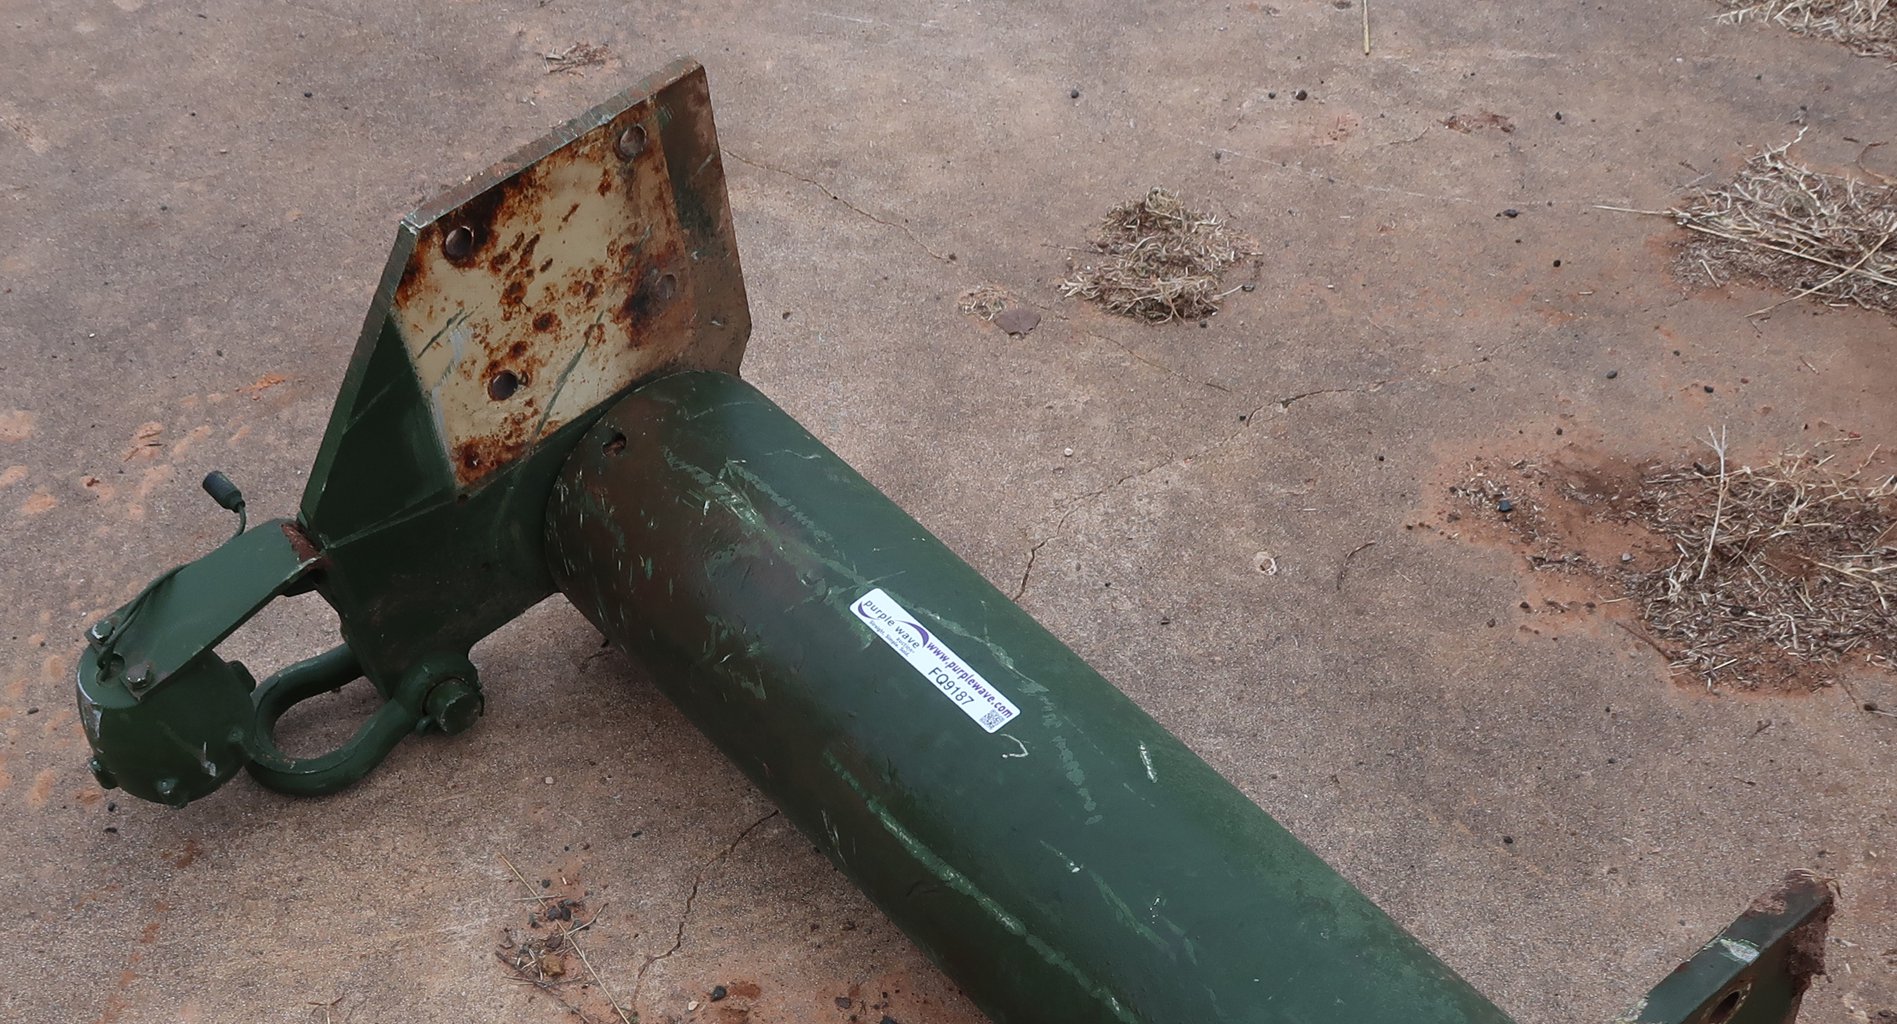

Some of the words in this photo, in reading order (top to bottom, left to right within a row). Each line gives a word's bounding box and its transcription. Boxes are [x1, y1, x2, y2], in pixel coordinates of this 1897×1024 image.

[864, 600, 895, 626] purple
[895, 625, 920, 648] wave
[927, 642, 1013, 718] www.purplewave.com
[928, 667, 975, 706] FQ9187
